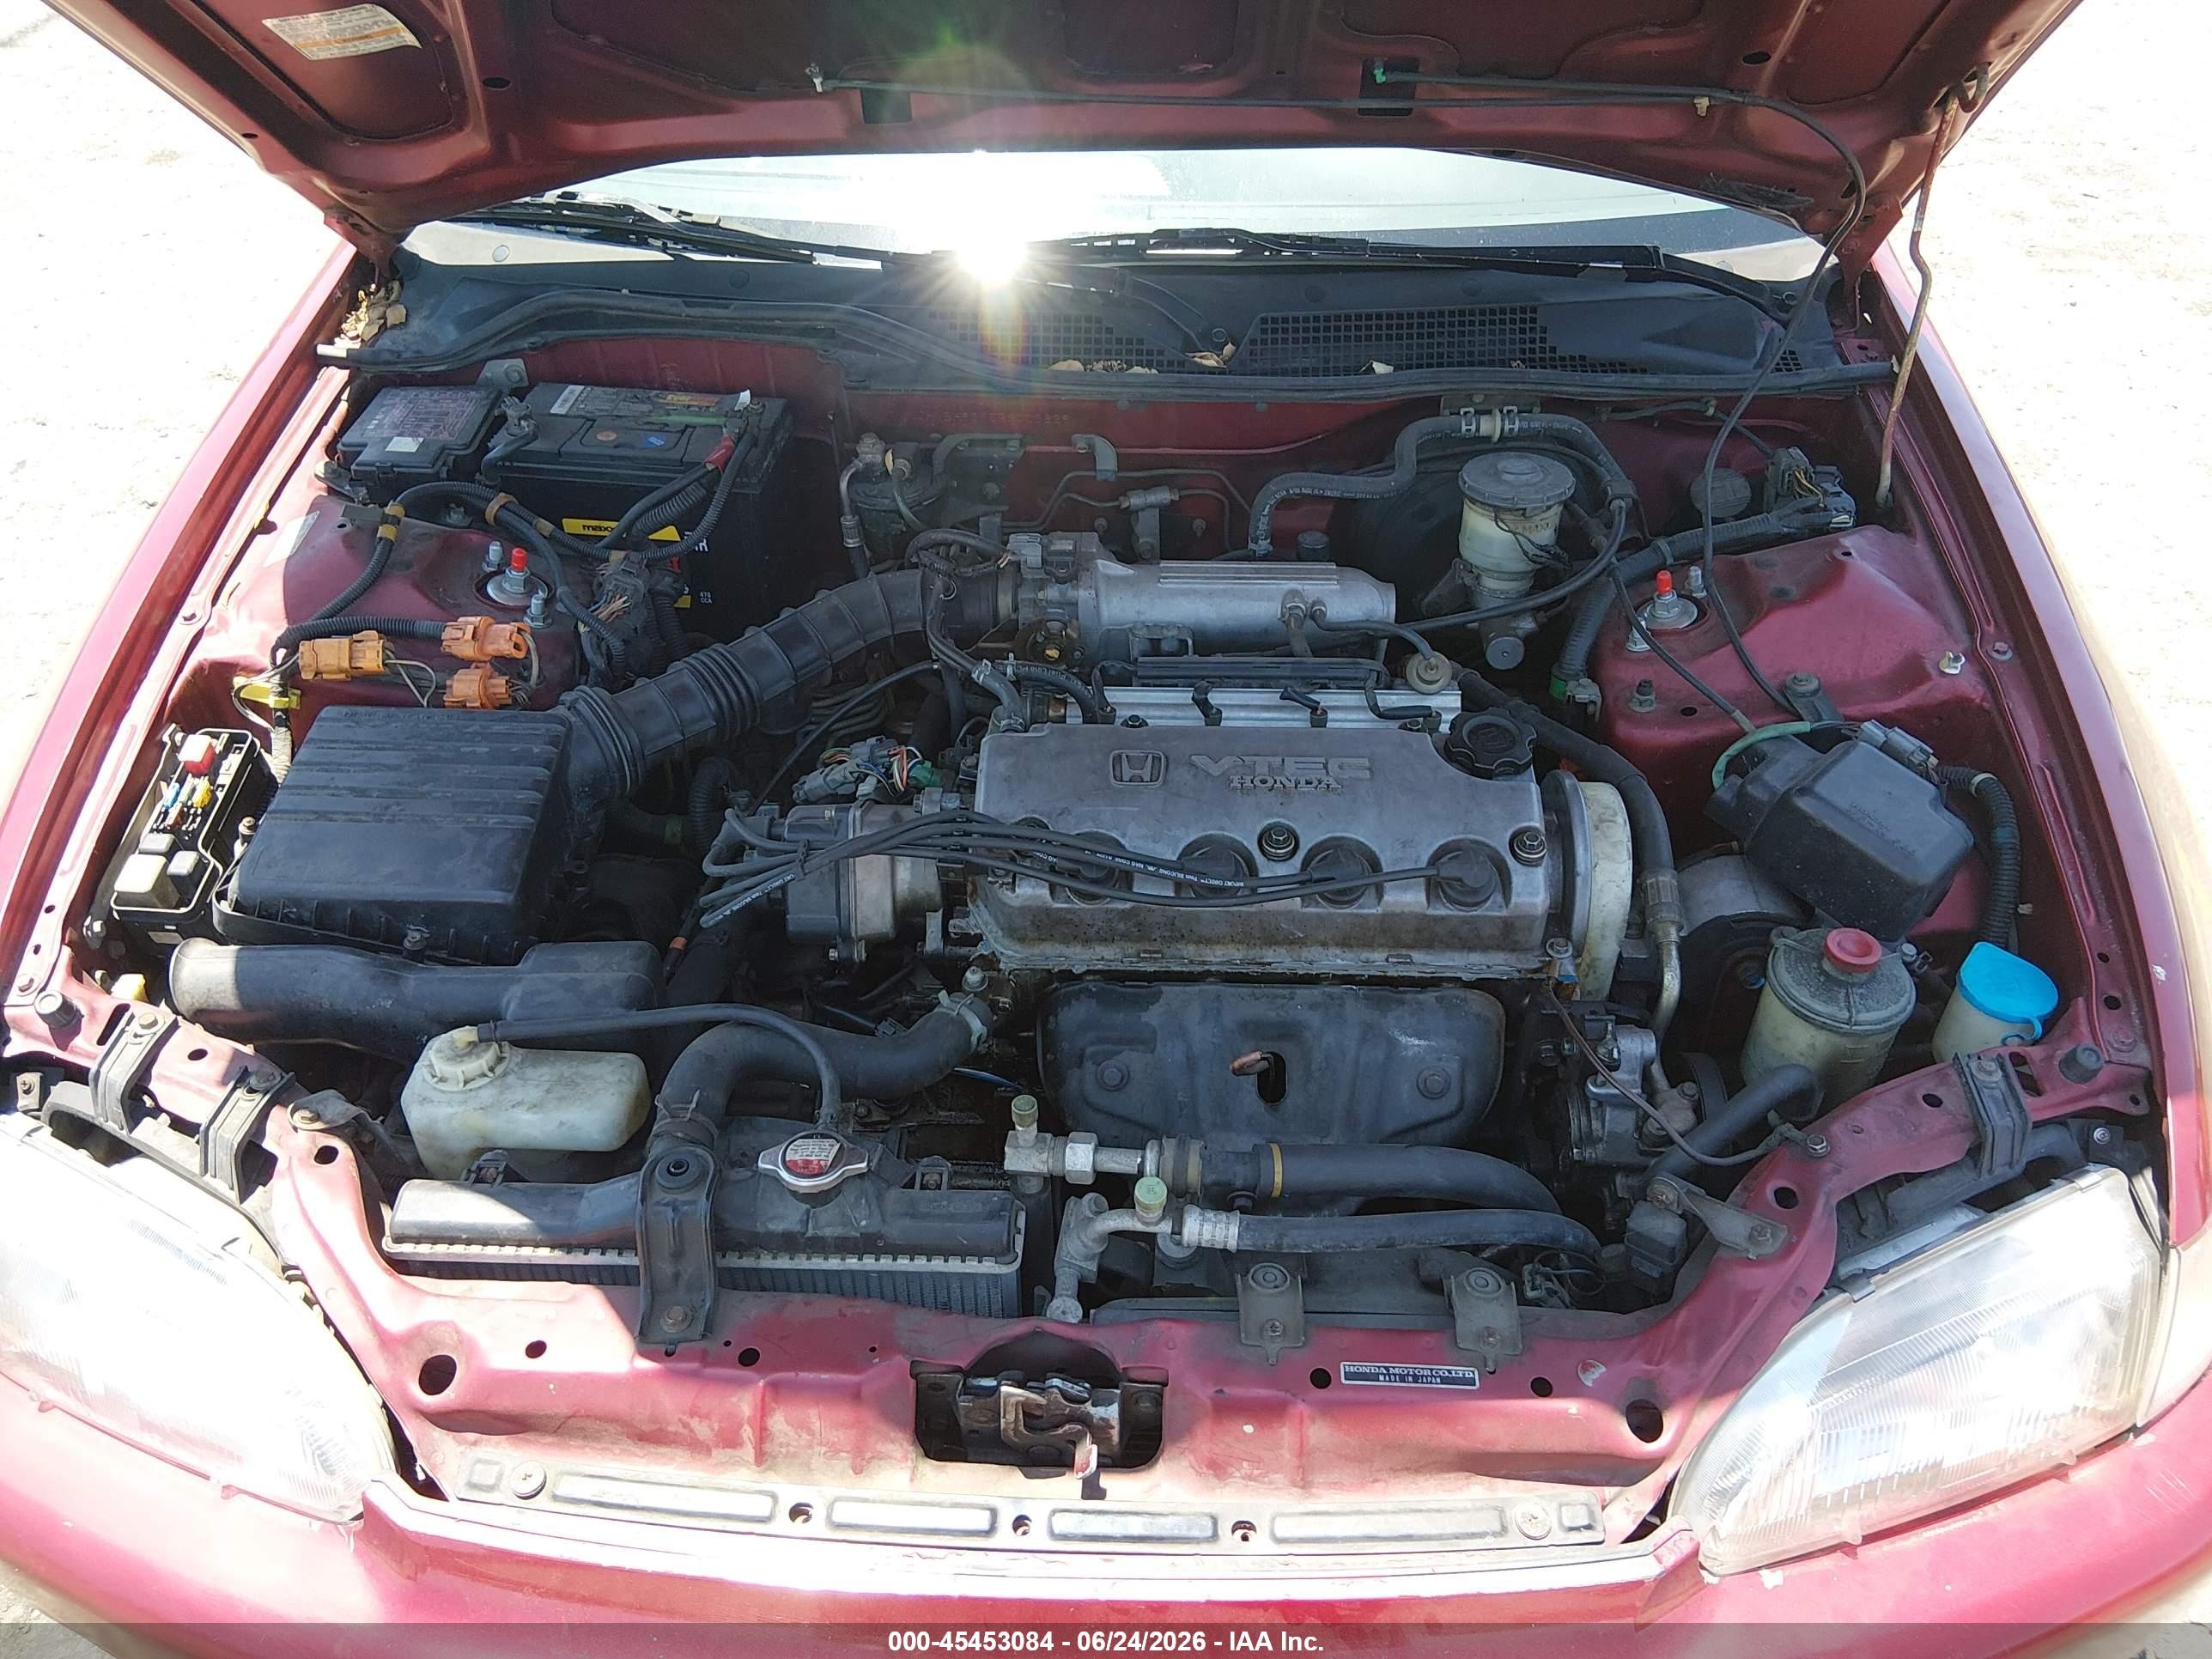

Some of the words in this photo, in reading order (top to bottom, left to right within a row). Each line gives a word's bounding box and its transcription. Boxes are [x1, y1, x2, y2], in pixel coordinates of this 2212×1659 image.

[1188, 755, 1371, 779] VTEC
[1229, 775, 1342, 791] HONDA
[1344, 1365, 1388, 1374] HONDA
[1389, 1367, 1431, 1376] MOTOR
